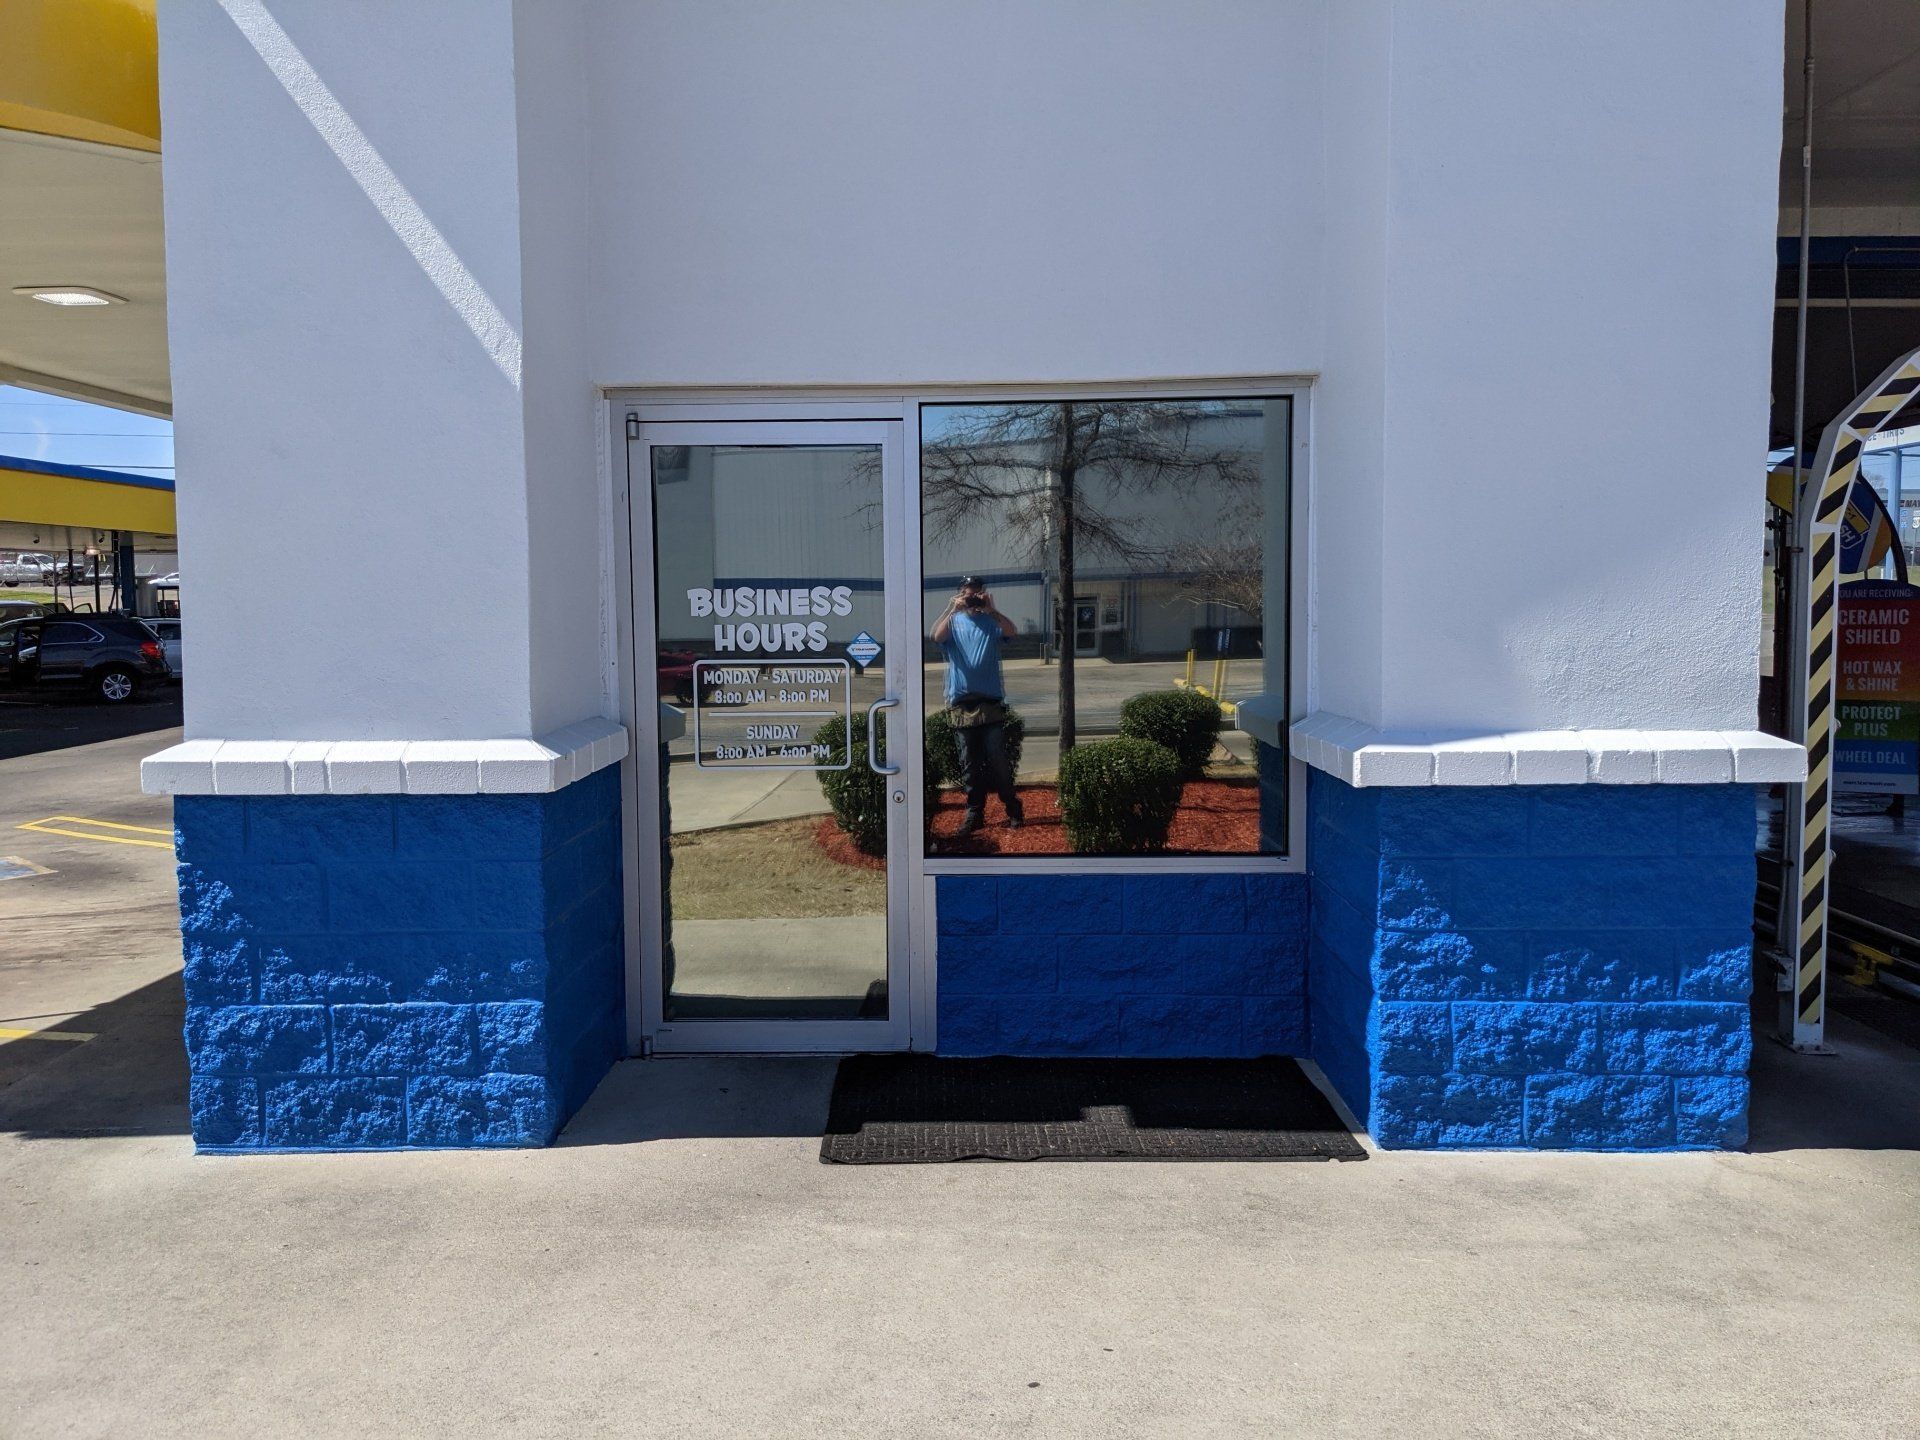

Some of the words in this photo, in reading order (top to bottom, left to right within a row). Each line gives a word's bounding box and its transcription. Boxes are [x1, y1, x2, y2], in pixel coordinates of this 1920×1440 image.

[1839, 589, 1852, 598] OU
[1853, 589, 1867, 598] ARE
[687, 586, 853, 617] BUSINESS
[1838, 608, 1910, 625] CERAMIC
[714, 621, 828, 652] HOURS
[1845, 628, 1901, 645] SHIELD
[1843, 661, 1869, 674] HOT
[1873, 661, 1901, 675] WAX
[703, 670, 760, 685] MONDAY
[772, 669, 842, 684] SATURDAY
[1846, 677, 1856, 691] &
[1858, 677, 1898, 692] SHINE
[715, 690, 742, 704] 8:00
[746, 690, 767, 703] AM
[779, 689, 806, 703] 8:00
[810, 689, 830, 703] PM
[1842, 706, 1901, 720] PROTECT
[746, 725, 800, 740] SUNDAY
[1854, 722, 1889, 737] PLUS
[716, 745, 743, 759] 8:00
[747, 746, 767, 759] AM
[780, 745, 806, 758] 6:00
[811, 744, 831, 758] PM
[1834, 750, 1874, 764] WHEEL
[1876, 751, 1907, 765] DEAL
